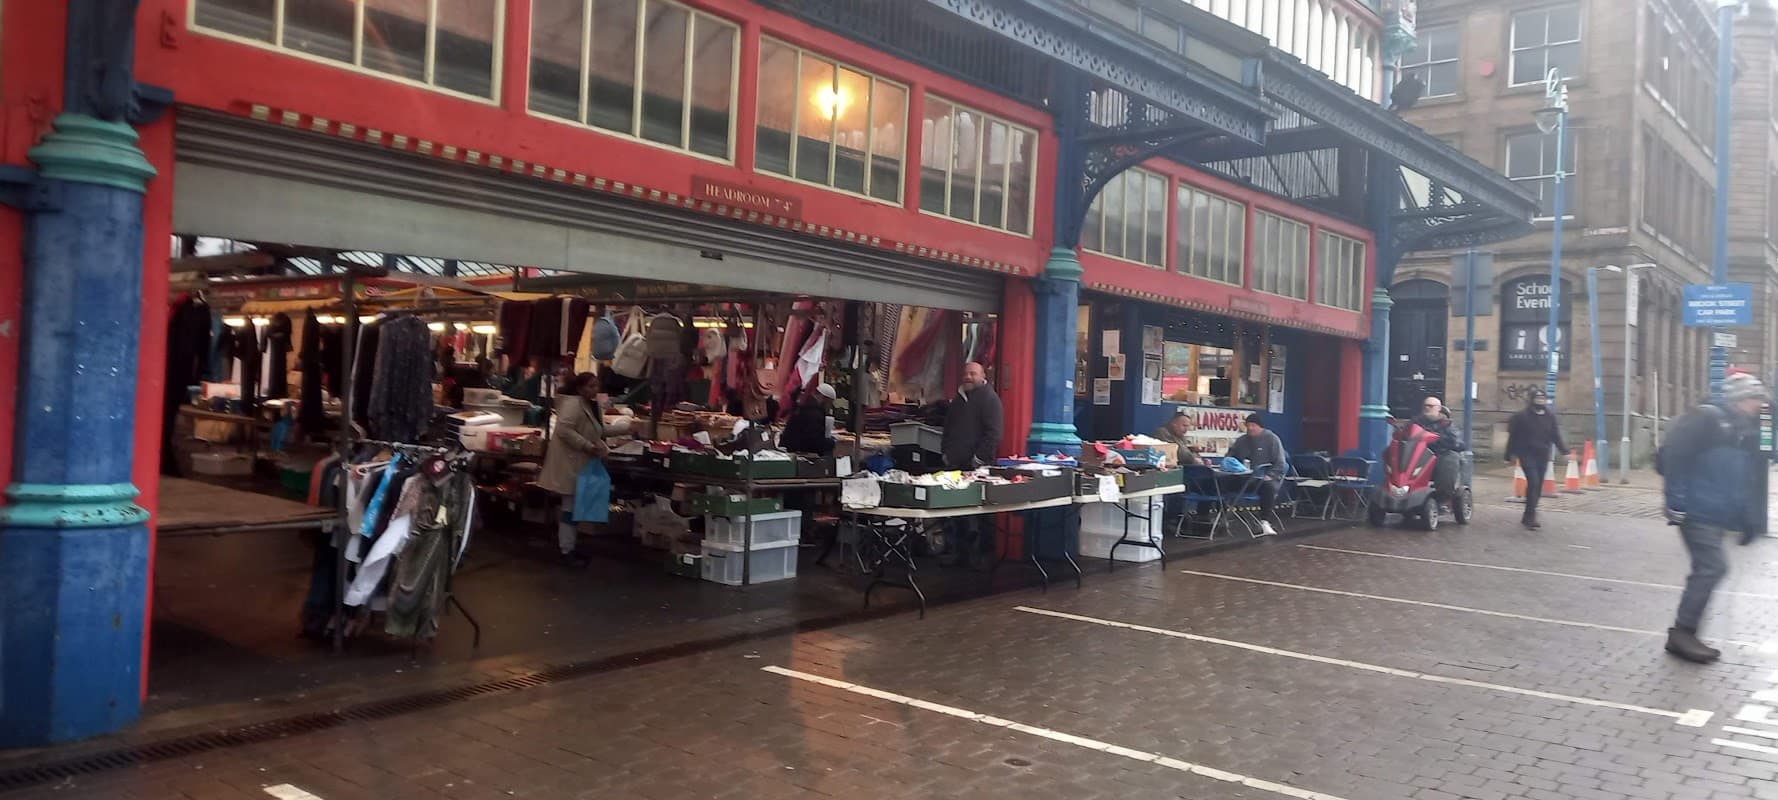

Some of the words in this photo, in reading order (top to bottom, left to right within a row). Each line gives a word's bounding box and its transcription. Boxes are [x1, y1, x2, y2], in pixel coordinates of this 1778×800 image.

[705, 183, 770, 208] HEADROOM
[1516, 282, 1553, 295] Scho
[1196, 411, 1239, 432] LANGOS
